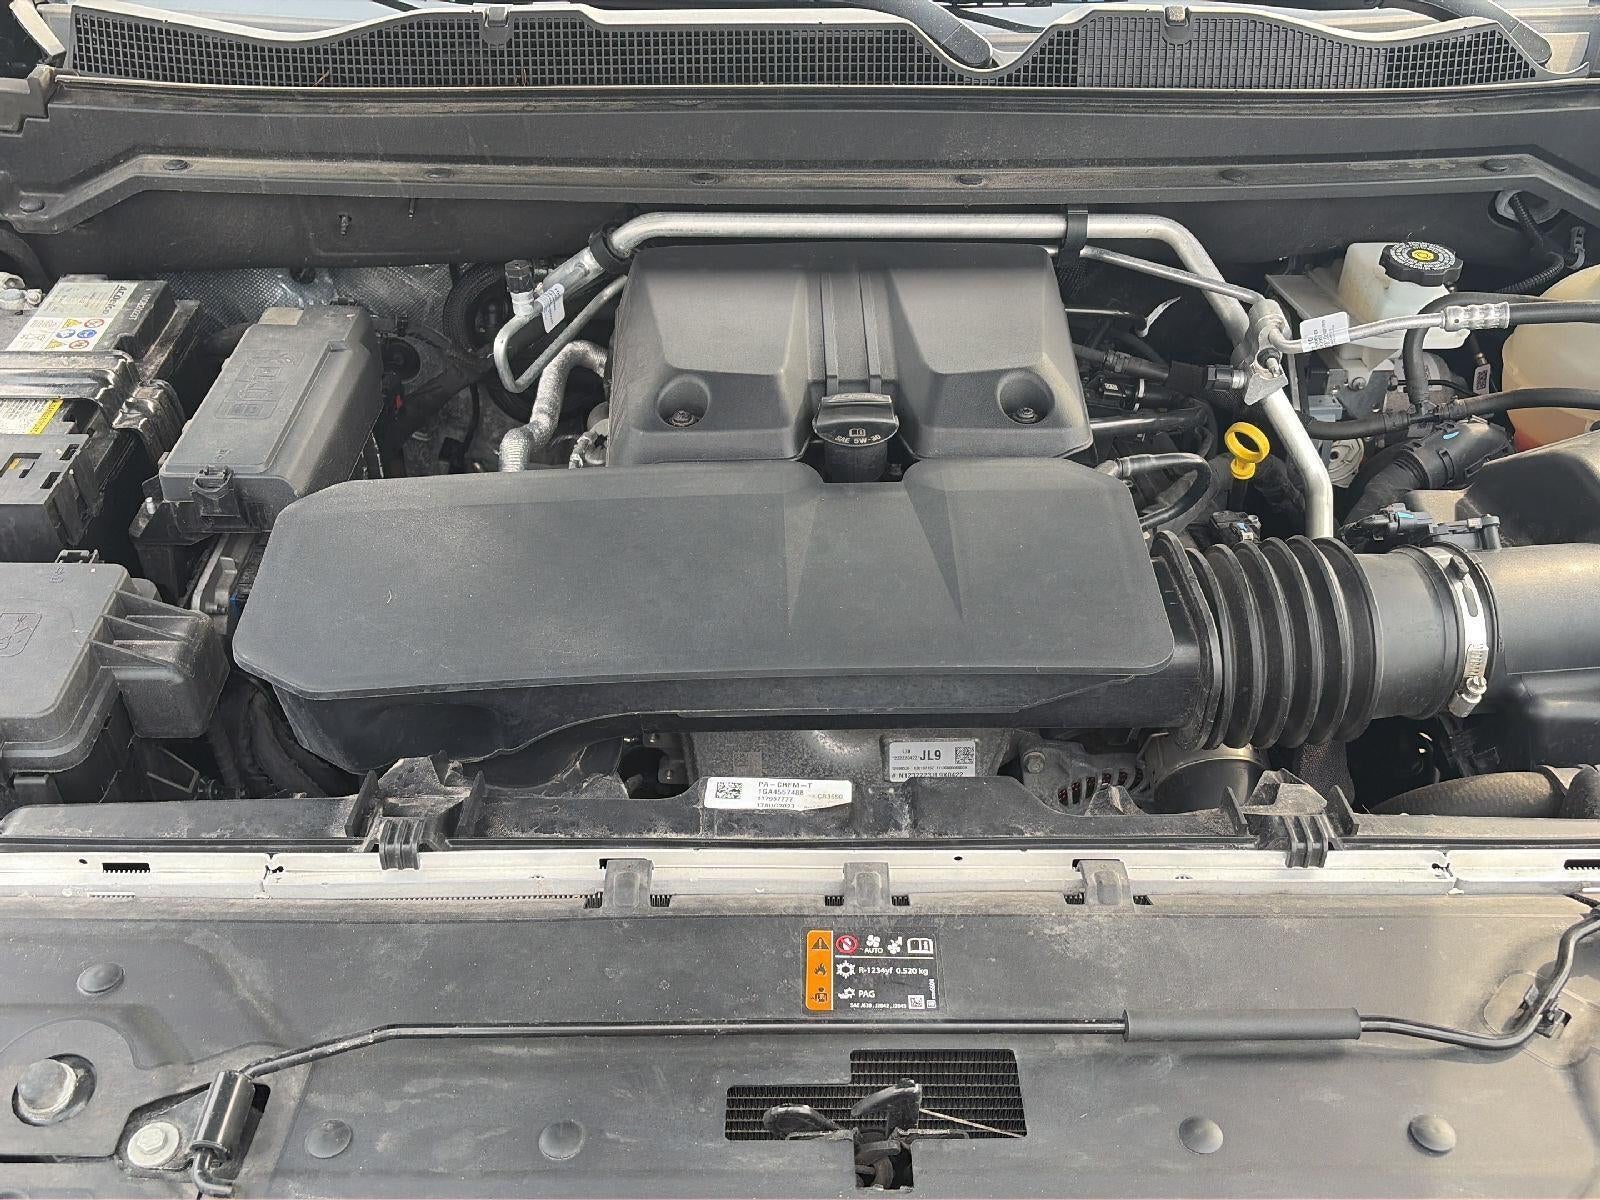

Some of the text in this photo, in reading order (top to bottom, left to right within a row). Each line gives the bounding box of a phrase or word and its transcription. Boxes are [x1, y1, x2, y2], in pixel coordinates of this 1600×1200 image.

[834, 434, 882, 444] SAE 5W-30
[919, 749, 942, 761] JL9
[858, 966, 929, 976] R-1234yf 0.520 kg
[858, 989, 876, 998] PAG
